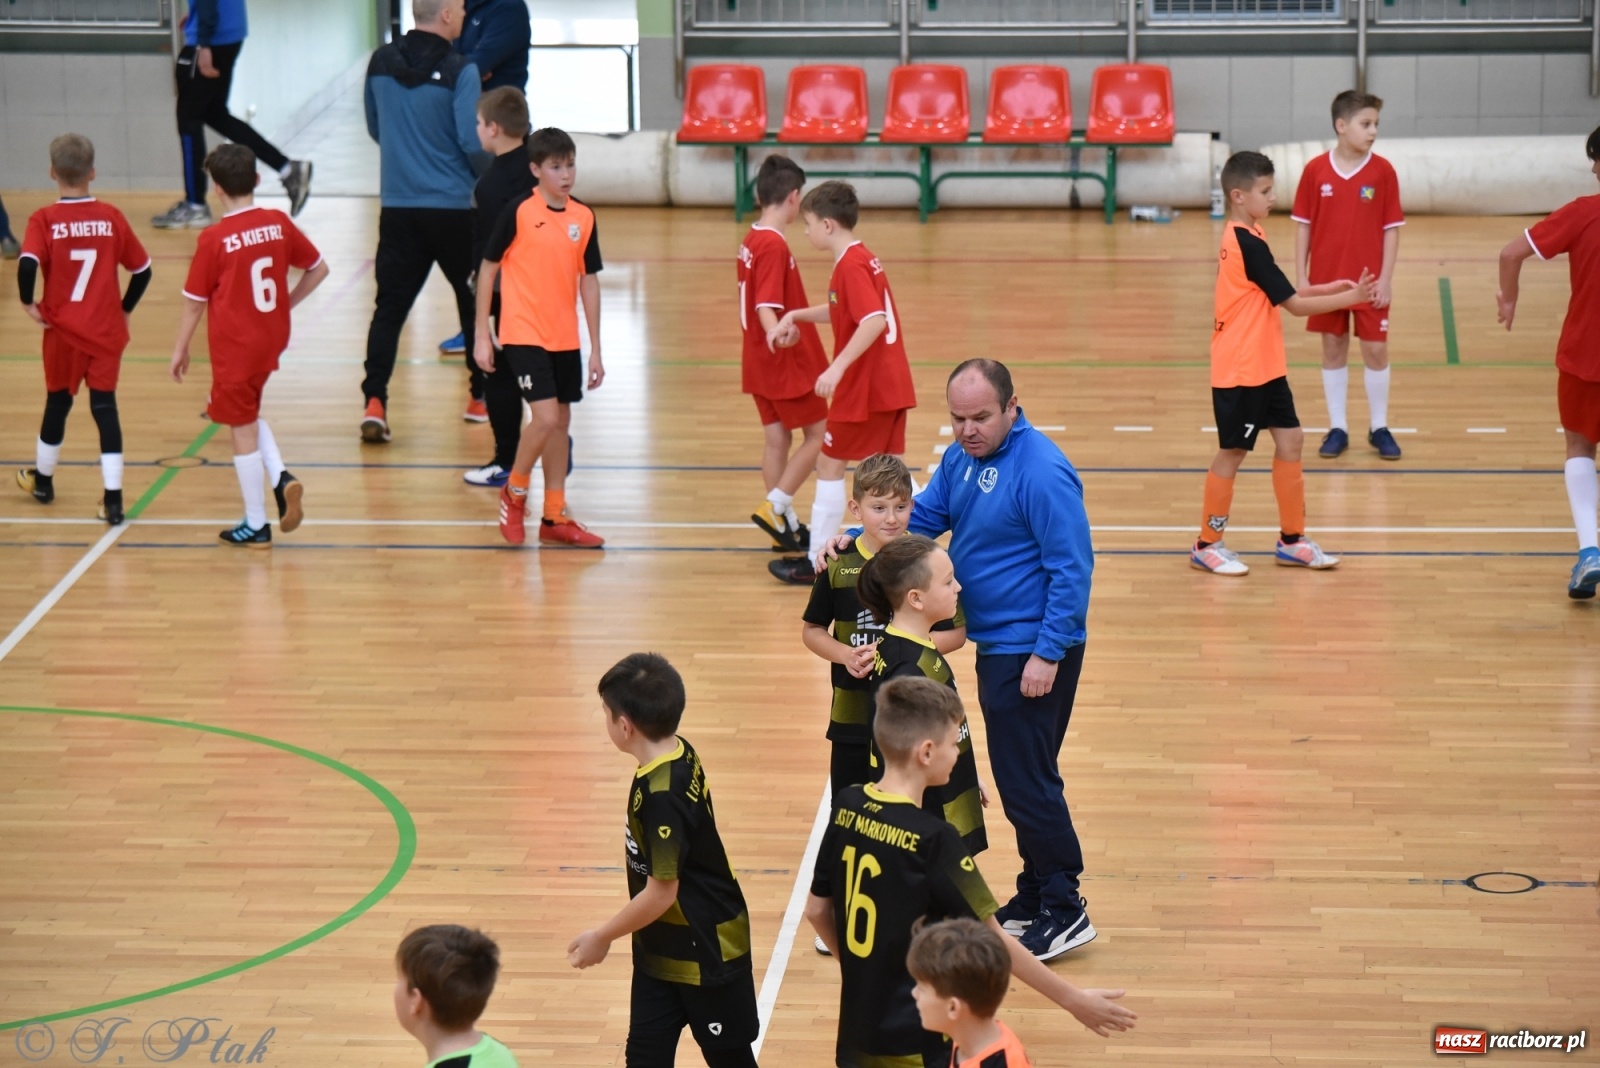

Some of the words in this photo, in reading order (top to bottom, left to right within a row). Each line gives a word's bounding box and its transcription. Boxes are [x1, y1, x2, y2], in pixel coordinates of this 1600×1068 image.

[52, 223, 68, 239] ZS
[70, 220, 113, 237] KIETRZ
[223, 233, 242, 253] ZS
[241, 224, 283, 247] KIETRZ
[70, 249, 97, 301] 7
[251, 256, 277, 312] 6
[1244, 423, 1254, 438] 7
[855, 814, 921, 852] MARKOWICE
[841, 845, 881, 958] 16
